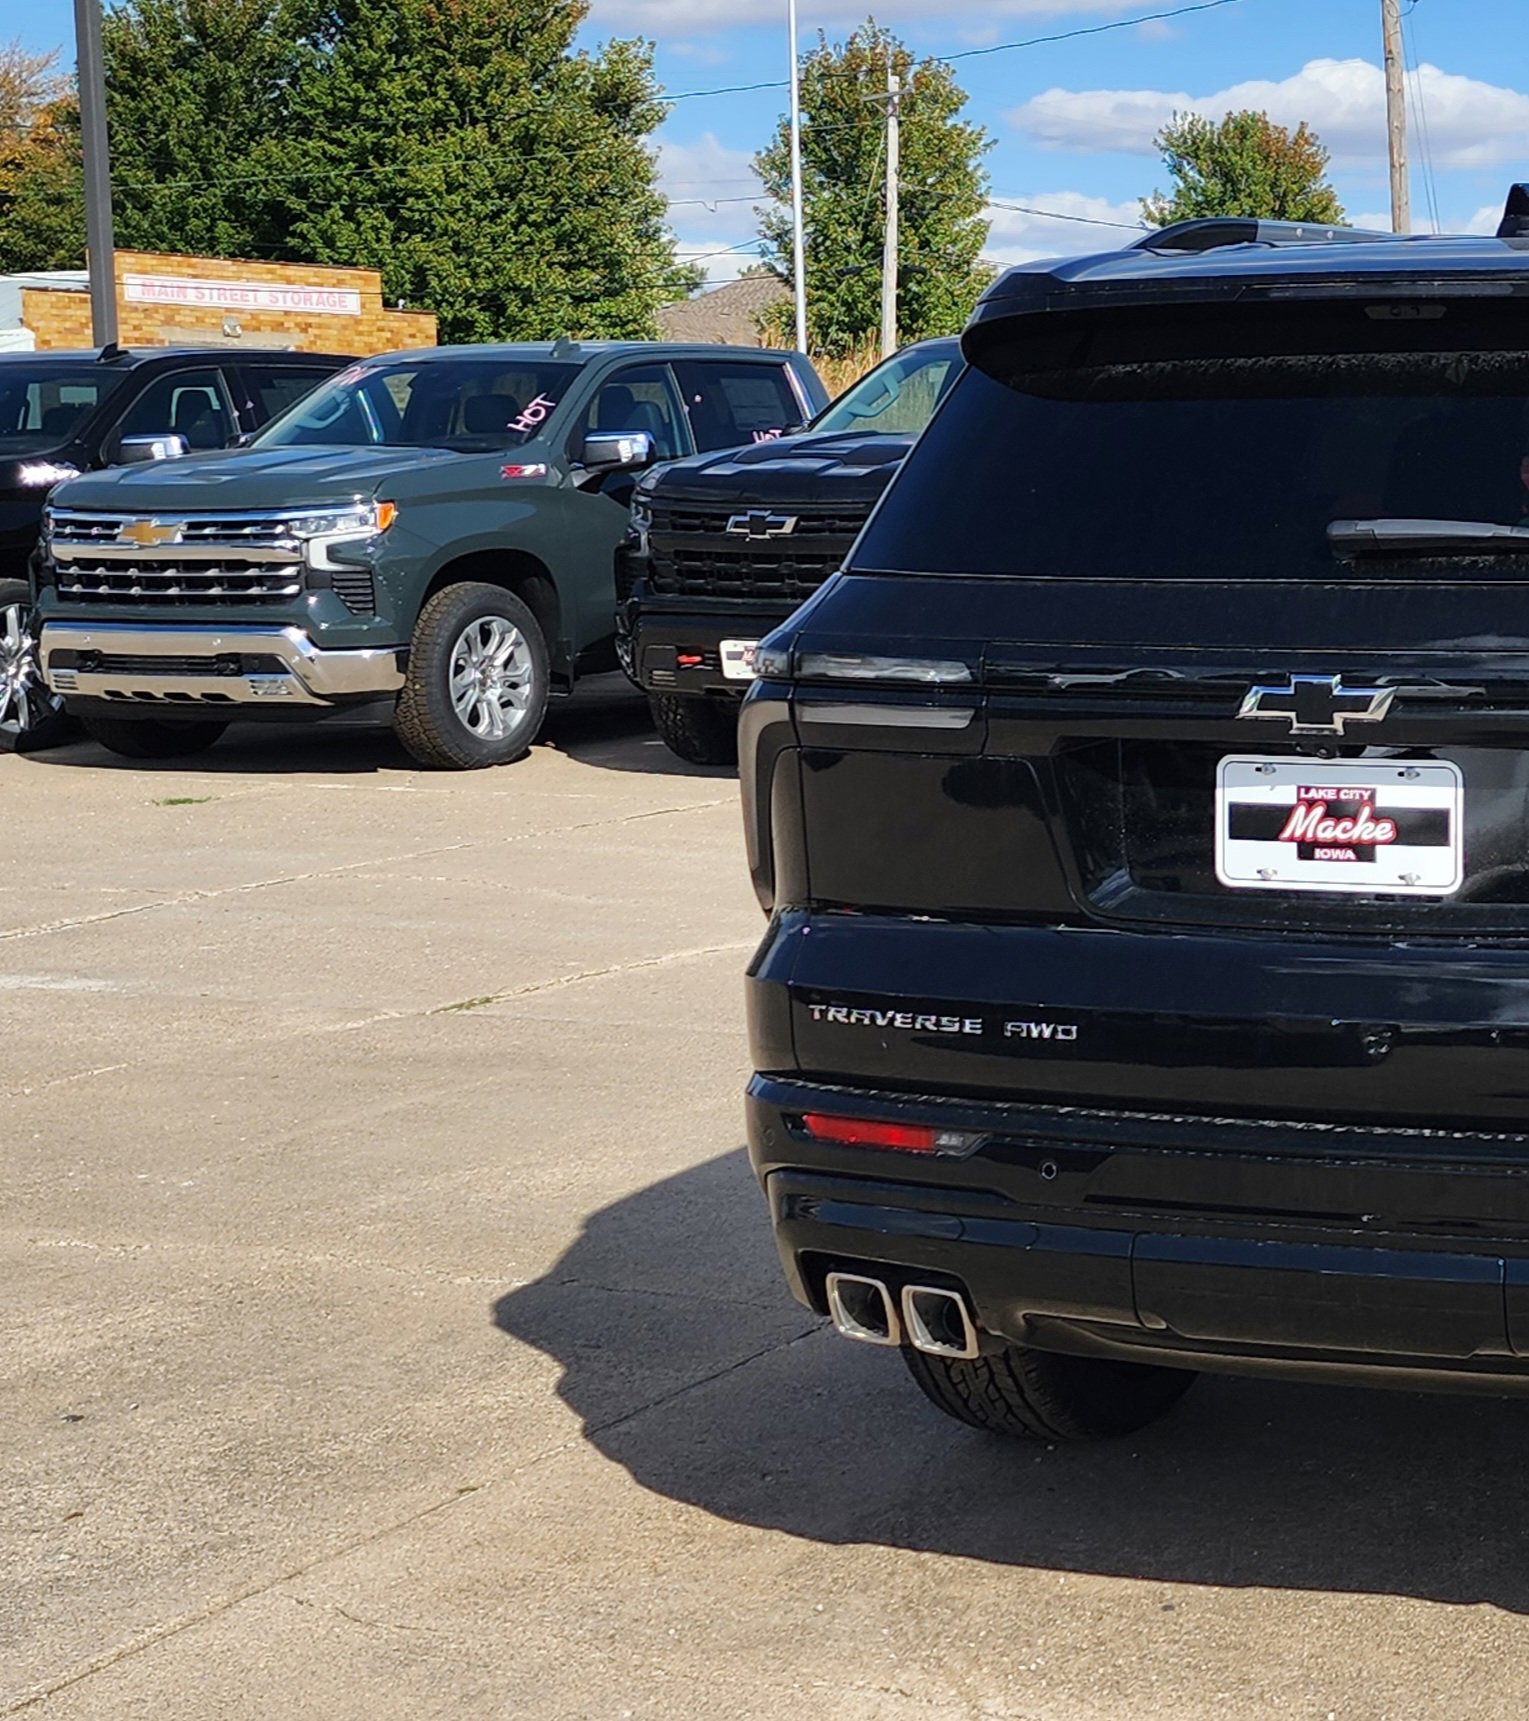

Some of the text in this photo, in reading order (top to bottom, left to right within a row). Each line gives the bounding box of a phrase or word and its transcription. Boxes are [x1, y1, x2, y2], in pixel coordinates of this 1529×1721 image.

[140, 280, 349, 309] MAIN STREET STORAGE
[507, 392, 556, 432] HOT
[753, 429, 783, 443] HOT
[1300, 788, 1372, 801] LAKE CITY
[1278, 800, 1399, 844] Macke
[1314, 848, 1357, 860] IOWA
[808, 1003, 1078, 1040] TRAVERSE AWD
